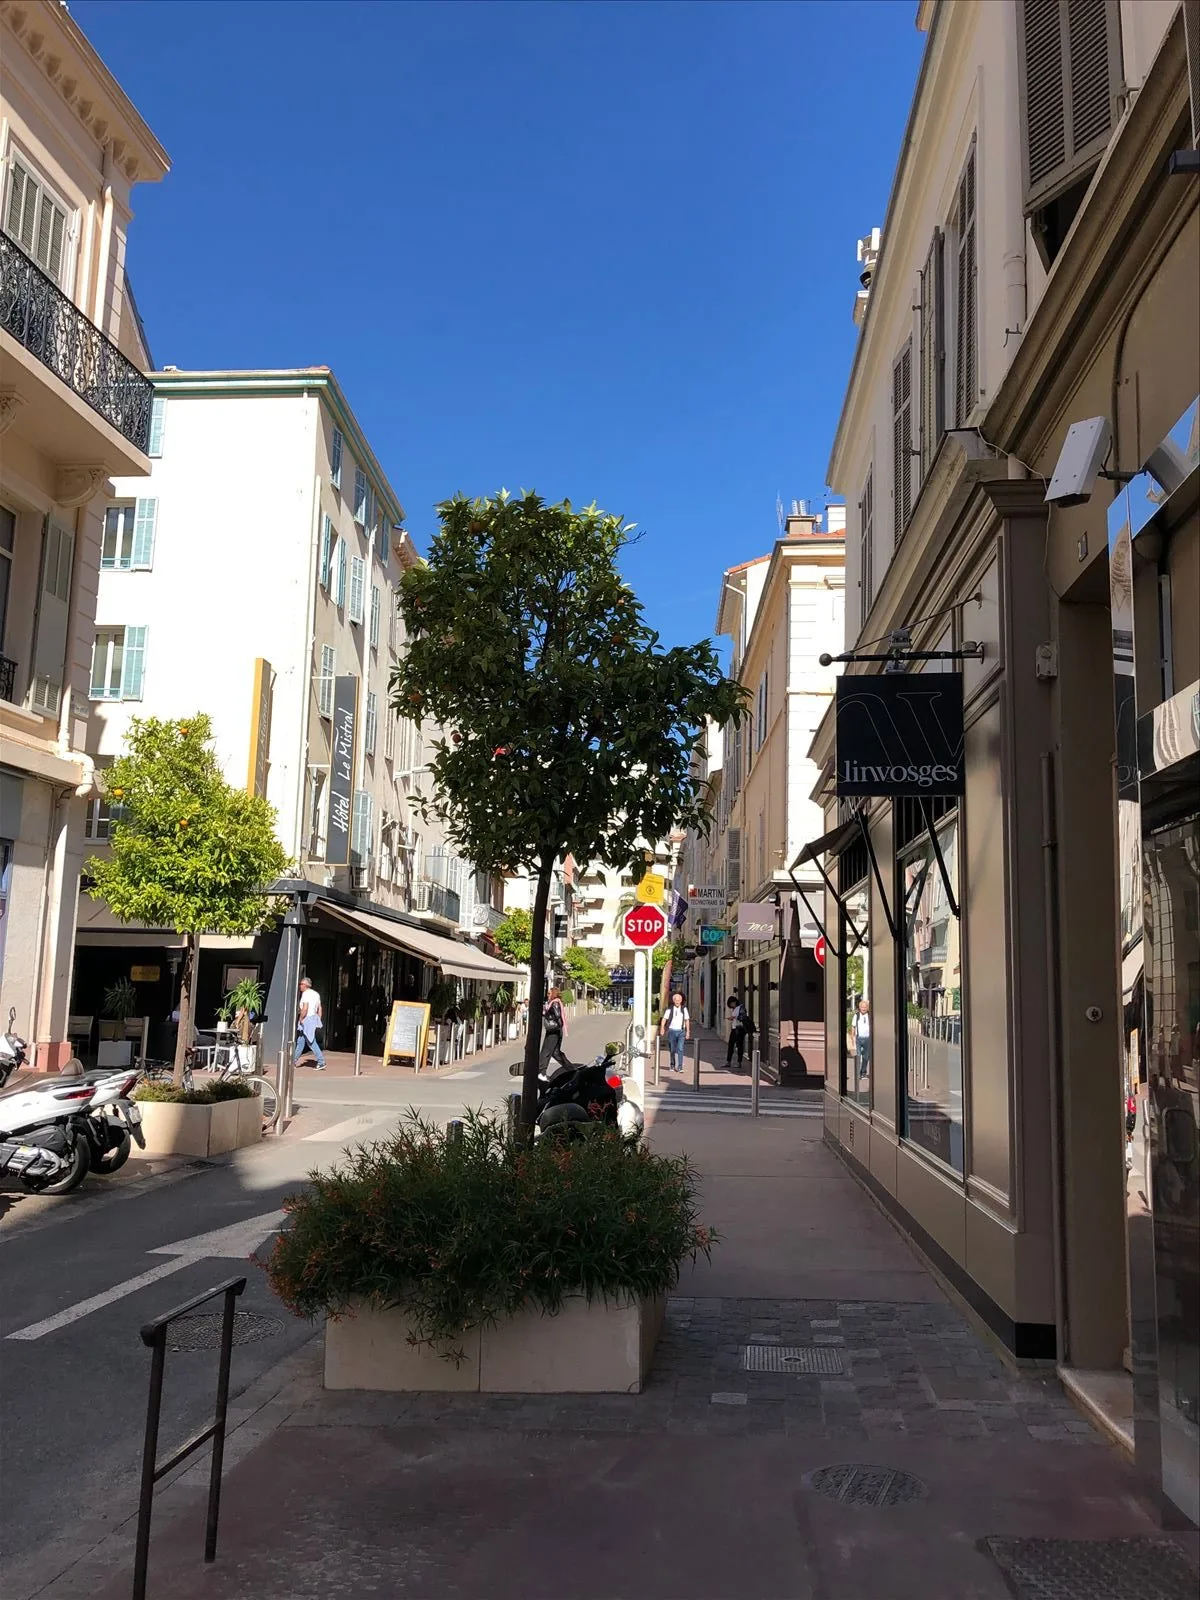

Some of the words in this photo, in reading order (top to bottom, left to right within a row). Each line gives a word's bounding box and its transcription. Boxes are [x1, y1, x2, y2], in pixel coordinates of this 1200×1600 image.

[338, 708, 354, 760] Mistral
[338, 762, 350, 781] Le
[844, 760, 957, 787] linvosges
[331, 791, 350, 833] Hôtel
[698, 888, 725, 898] MARTINI
[627, 919, 662, 933] STOP
